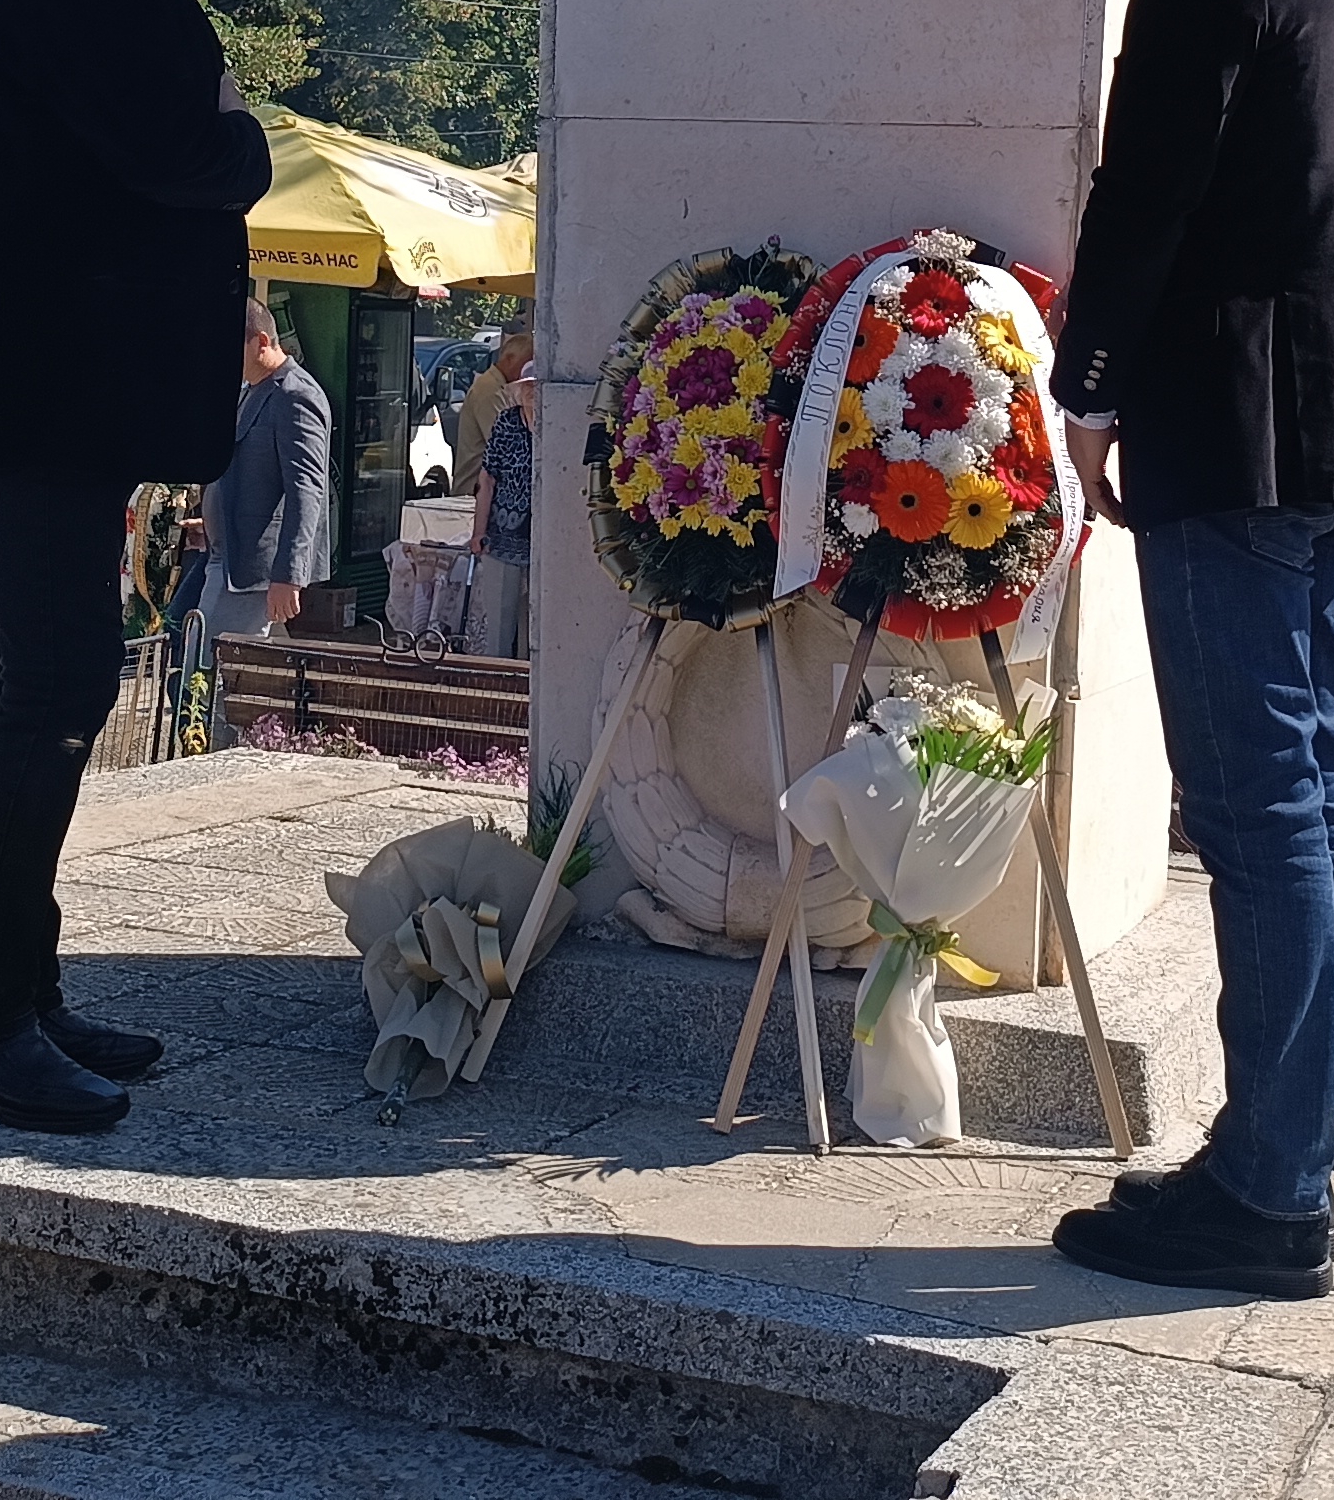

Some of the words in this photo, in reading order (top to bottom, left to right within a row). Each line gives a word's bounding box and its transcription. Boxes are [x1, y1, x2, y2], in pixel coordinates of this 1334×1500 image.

[248, 249, 298, 264] ДРАВЕ
[302, 251, 324, 266] ЗА
[327, 253, 359, 269] НАС
